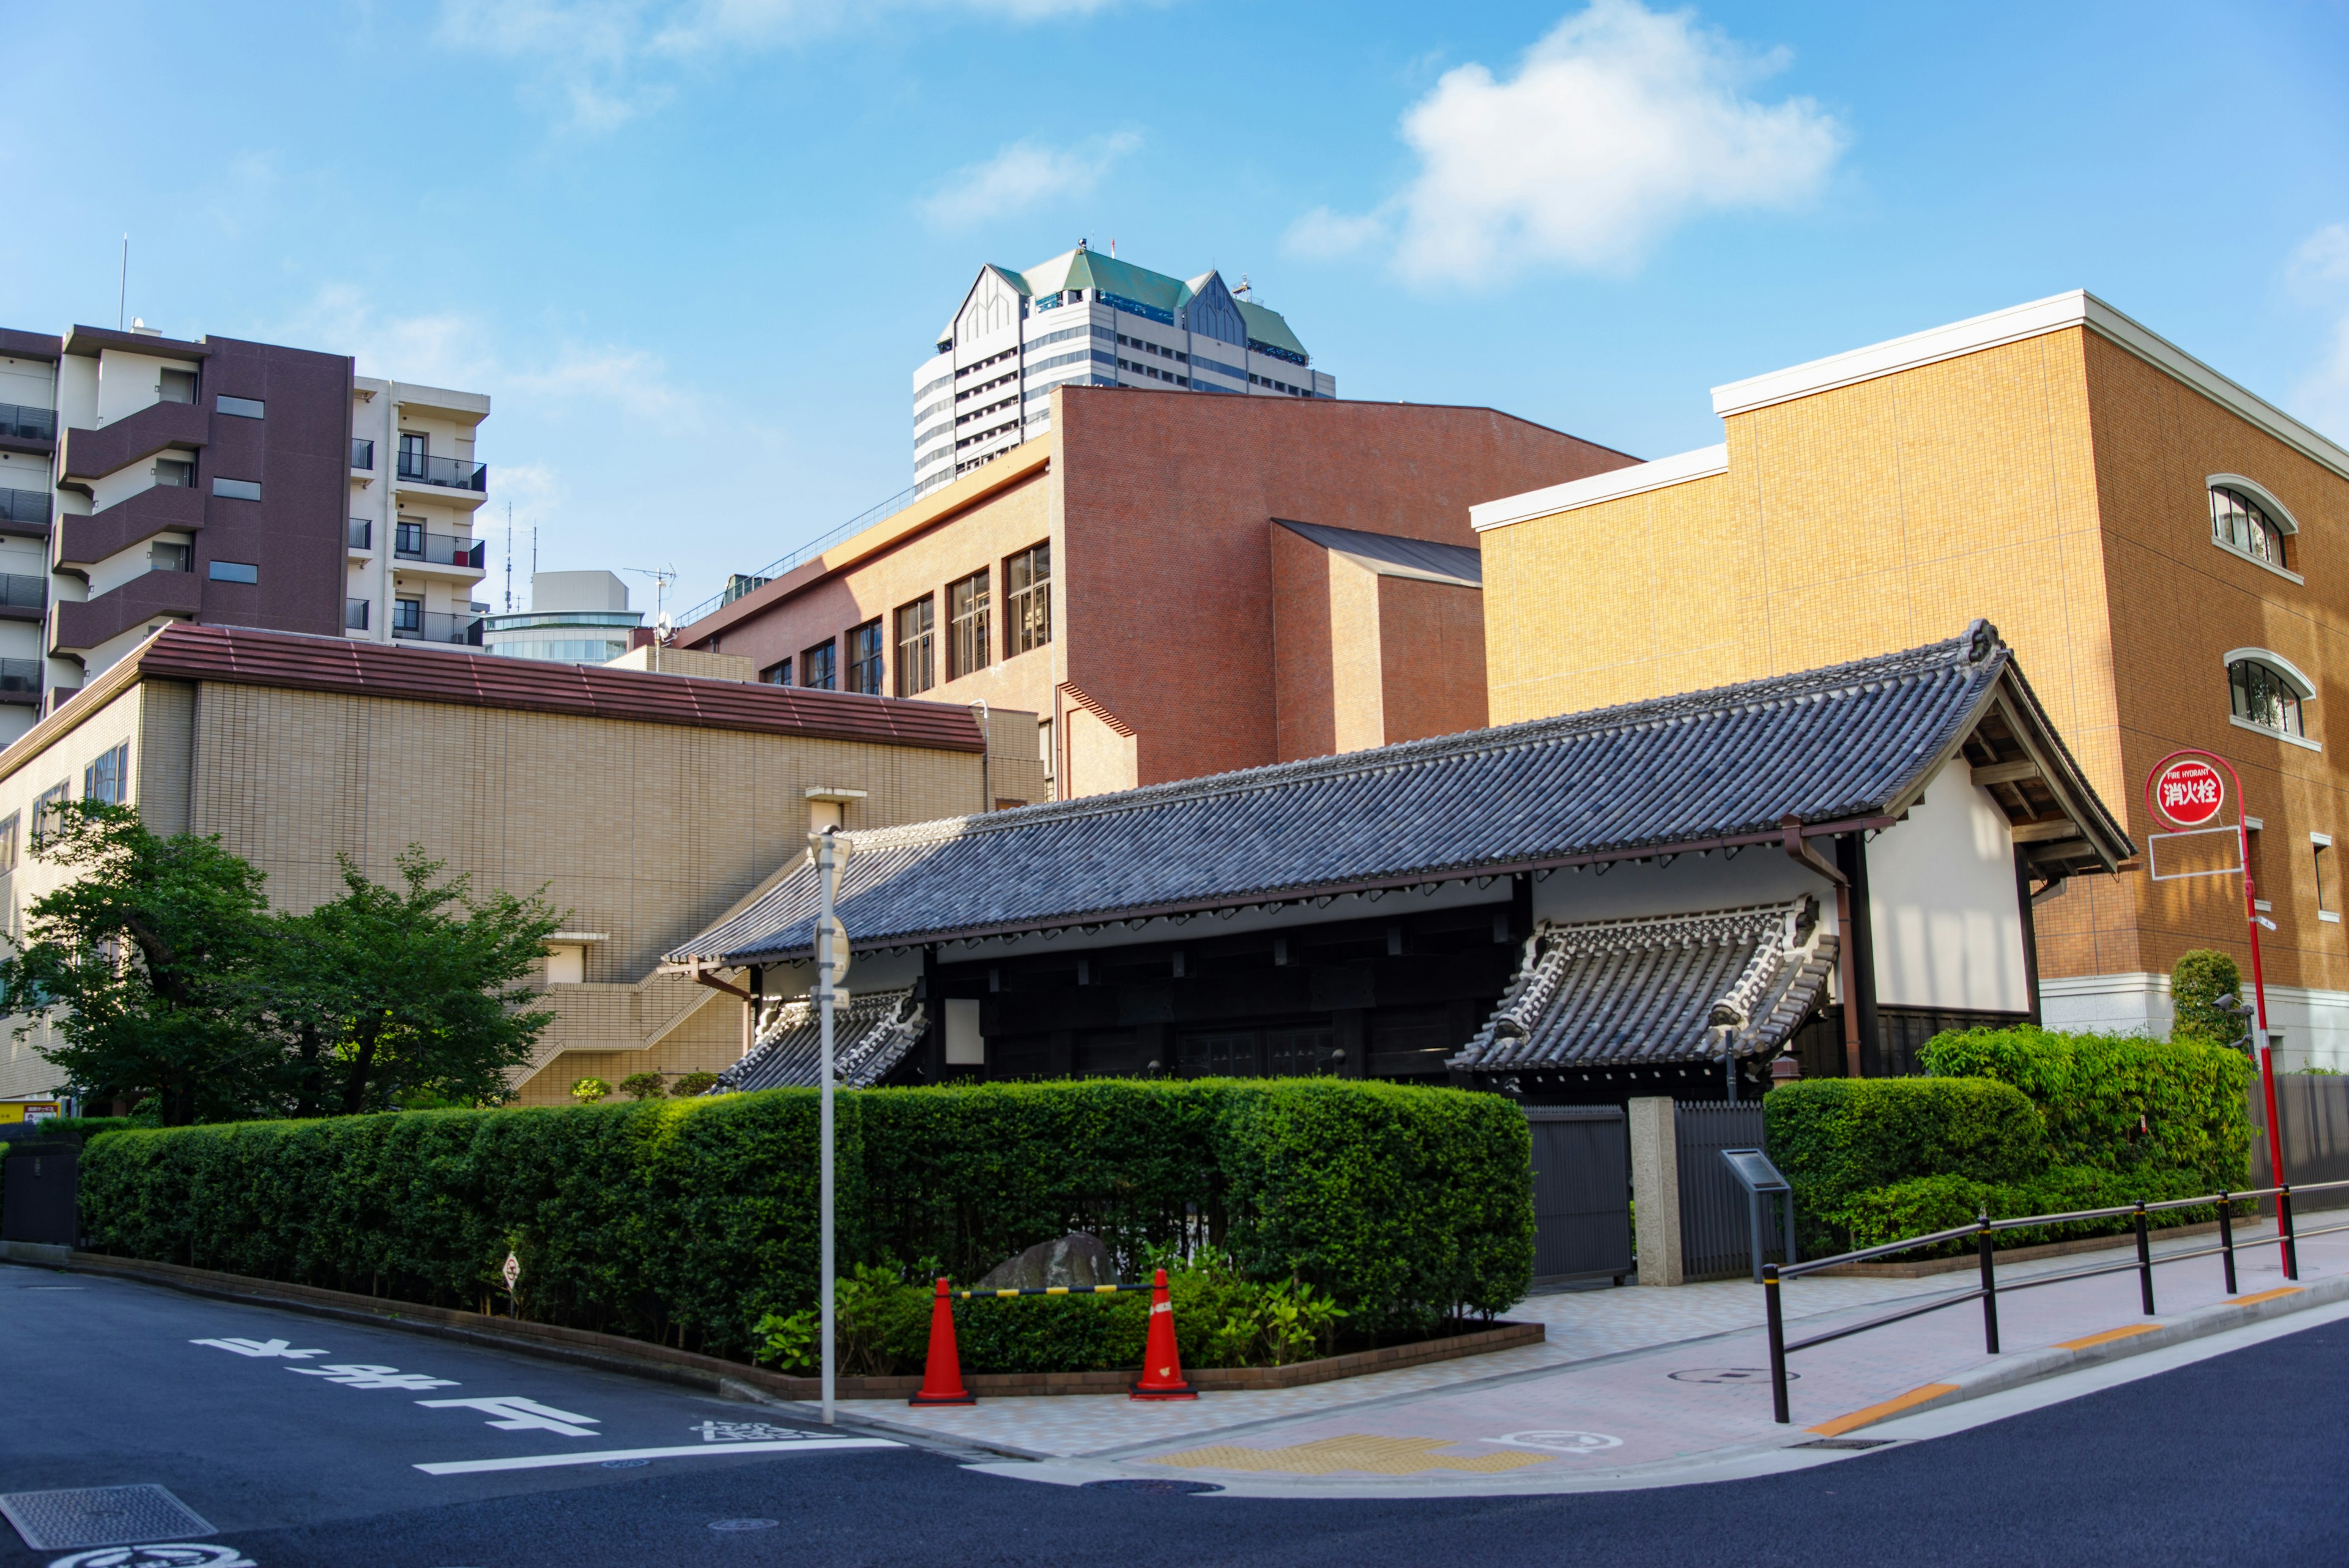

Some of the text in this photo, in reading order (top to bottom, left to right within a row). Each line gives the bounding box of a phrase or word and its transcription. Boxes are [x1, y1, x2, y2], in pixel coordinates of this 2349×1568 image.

[2182, 768, 2209, 778] HYDRANT
[2164, 778, 2217, 807] 消火栓
[188, 1337, 602, 1437] 止まれ
